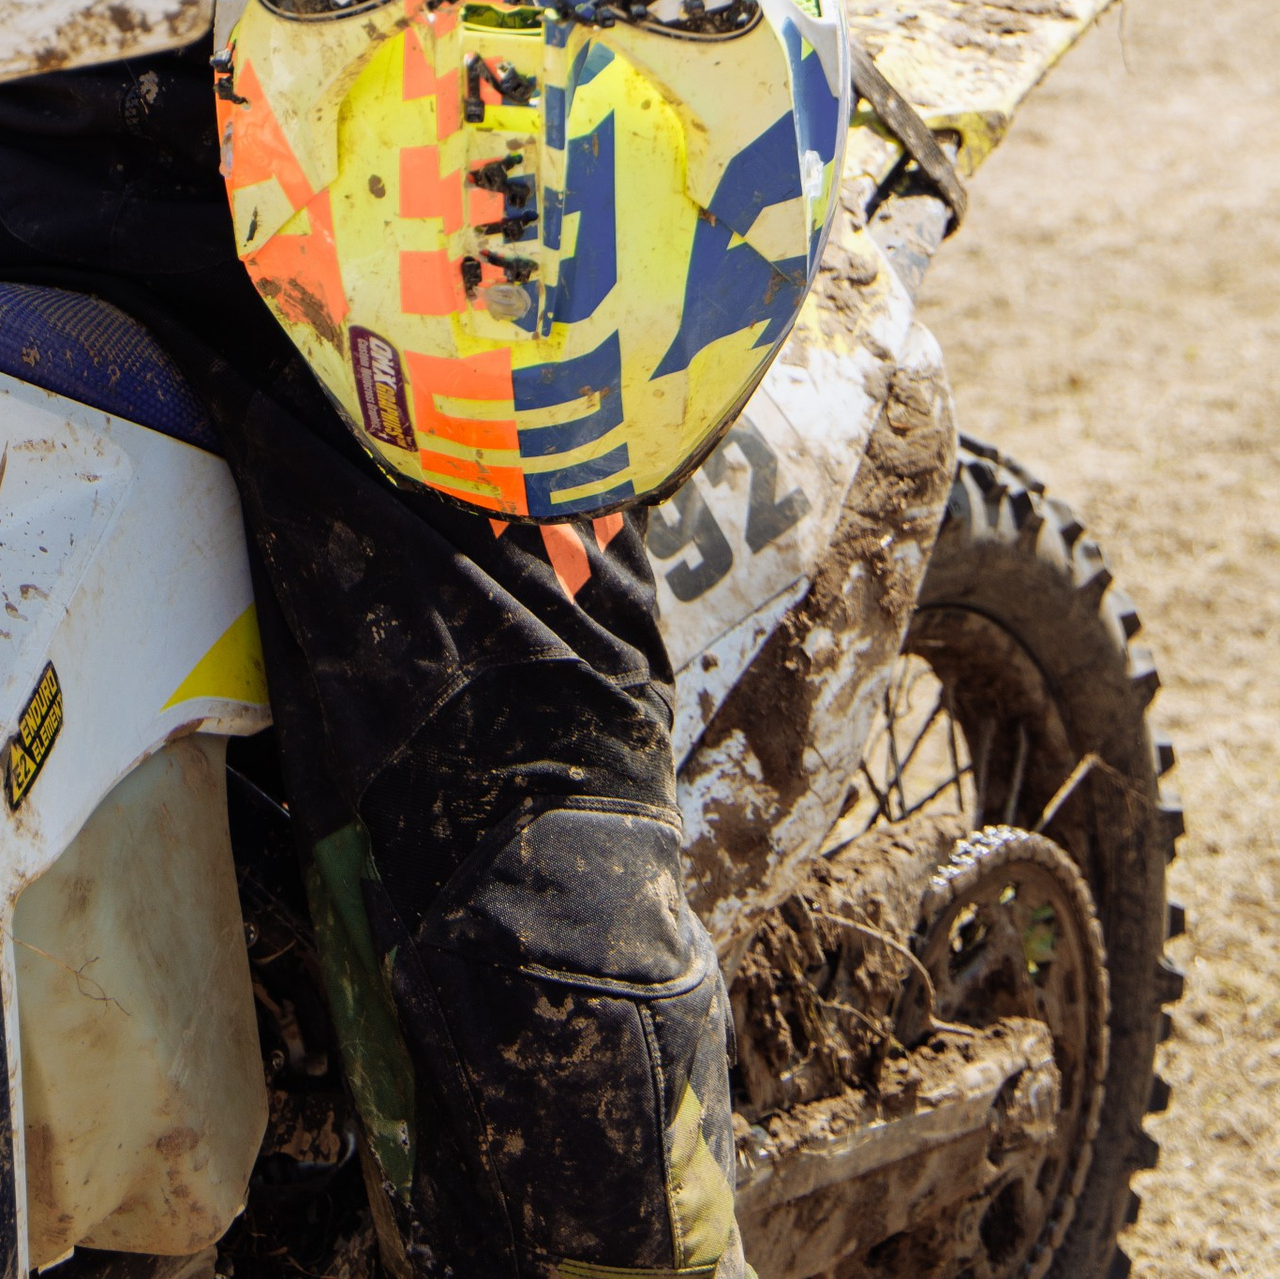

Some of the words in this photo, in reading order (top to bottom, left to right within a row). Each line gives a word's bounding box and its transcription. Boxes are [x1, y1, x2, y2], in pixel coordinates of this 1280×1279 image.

[375, 382, 405, 437] GRAPHICS
[19, 668, 58, 748] ENDURO
[31, 692, 64, 765] ELEMENT
